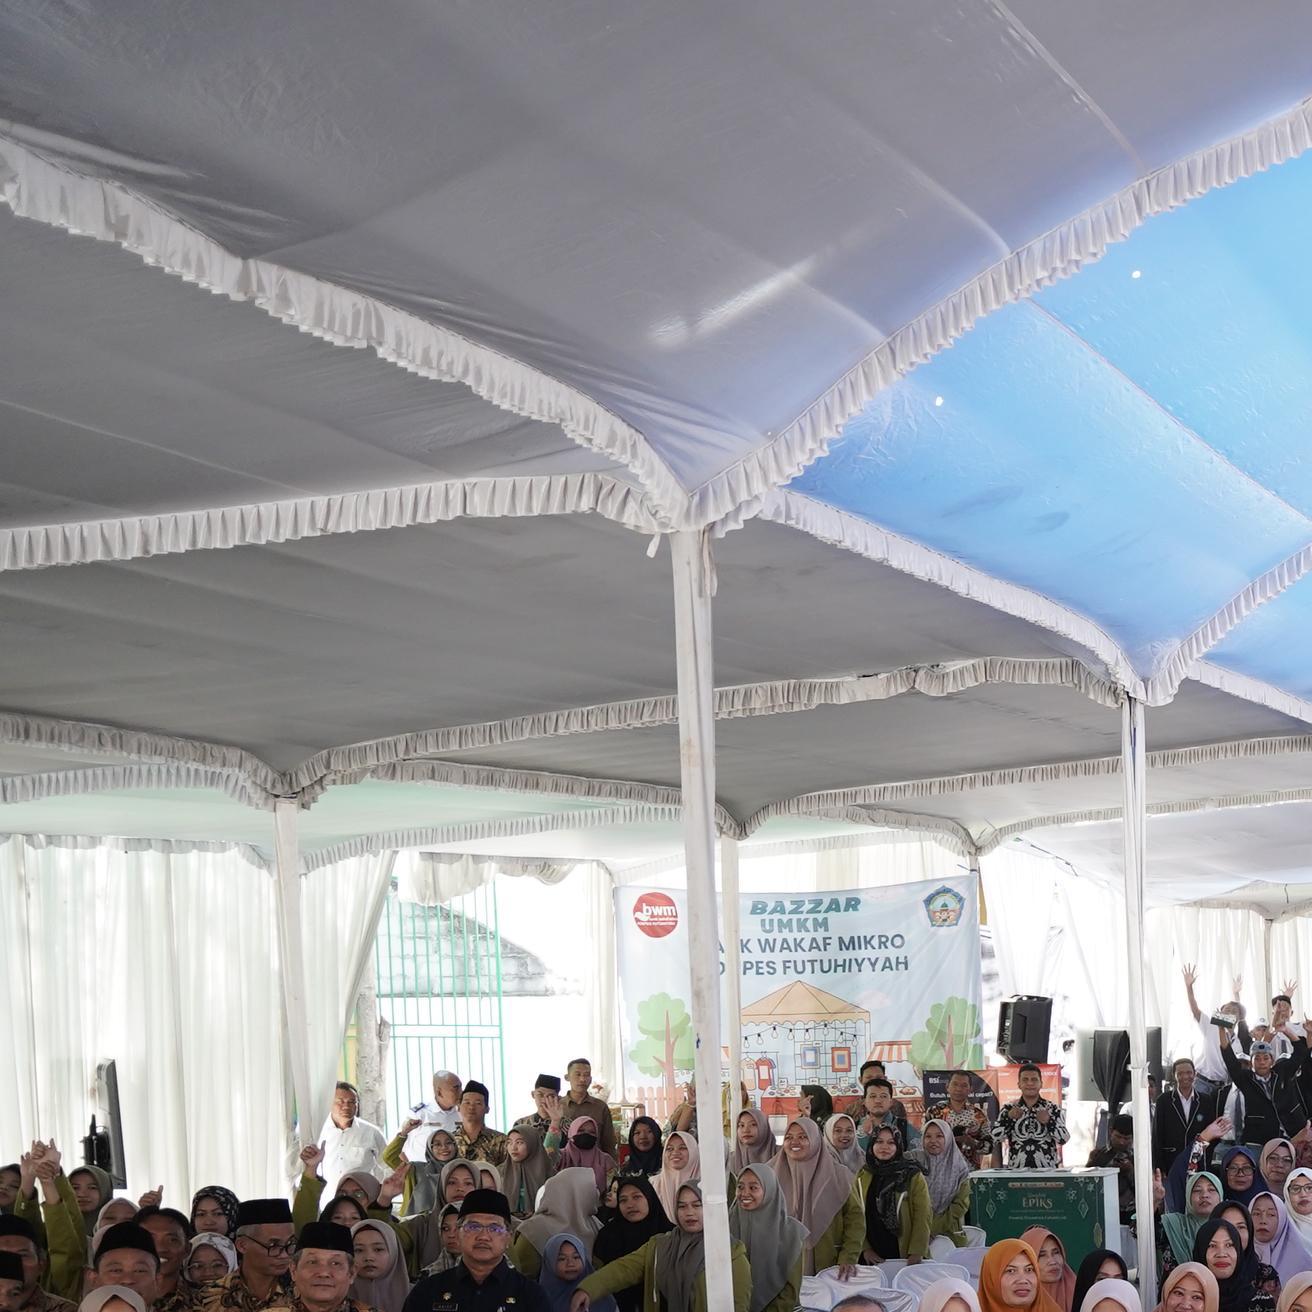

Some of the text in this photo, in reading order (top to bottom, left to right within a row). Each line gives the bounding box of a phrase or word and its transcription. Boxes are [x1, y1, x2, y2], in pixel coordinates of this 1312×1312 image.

[642, 902, 677, 916] bwm
[750, 897, 862, 915] BAZZAR
[760, 917, 830, 935] UMKM
[758, 936, 832, 954] WAKAF
[838, 933, 905, 952] MIKRO
[783, 955, 909, 975] FUTUHIYYAH
